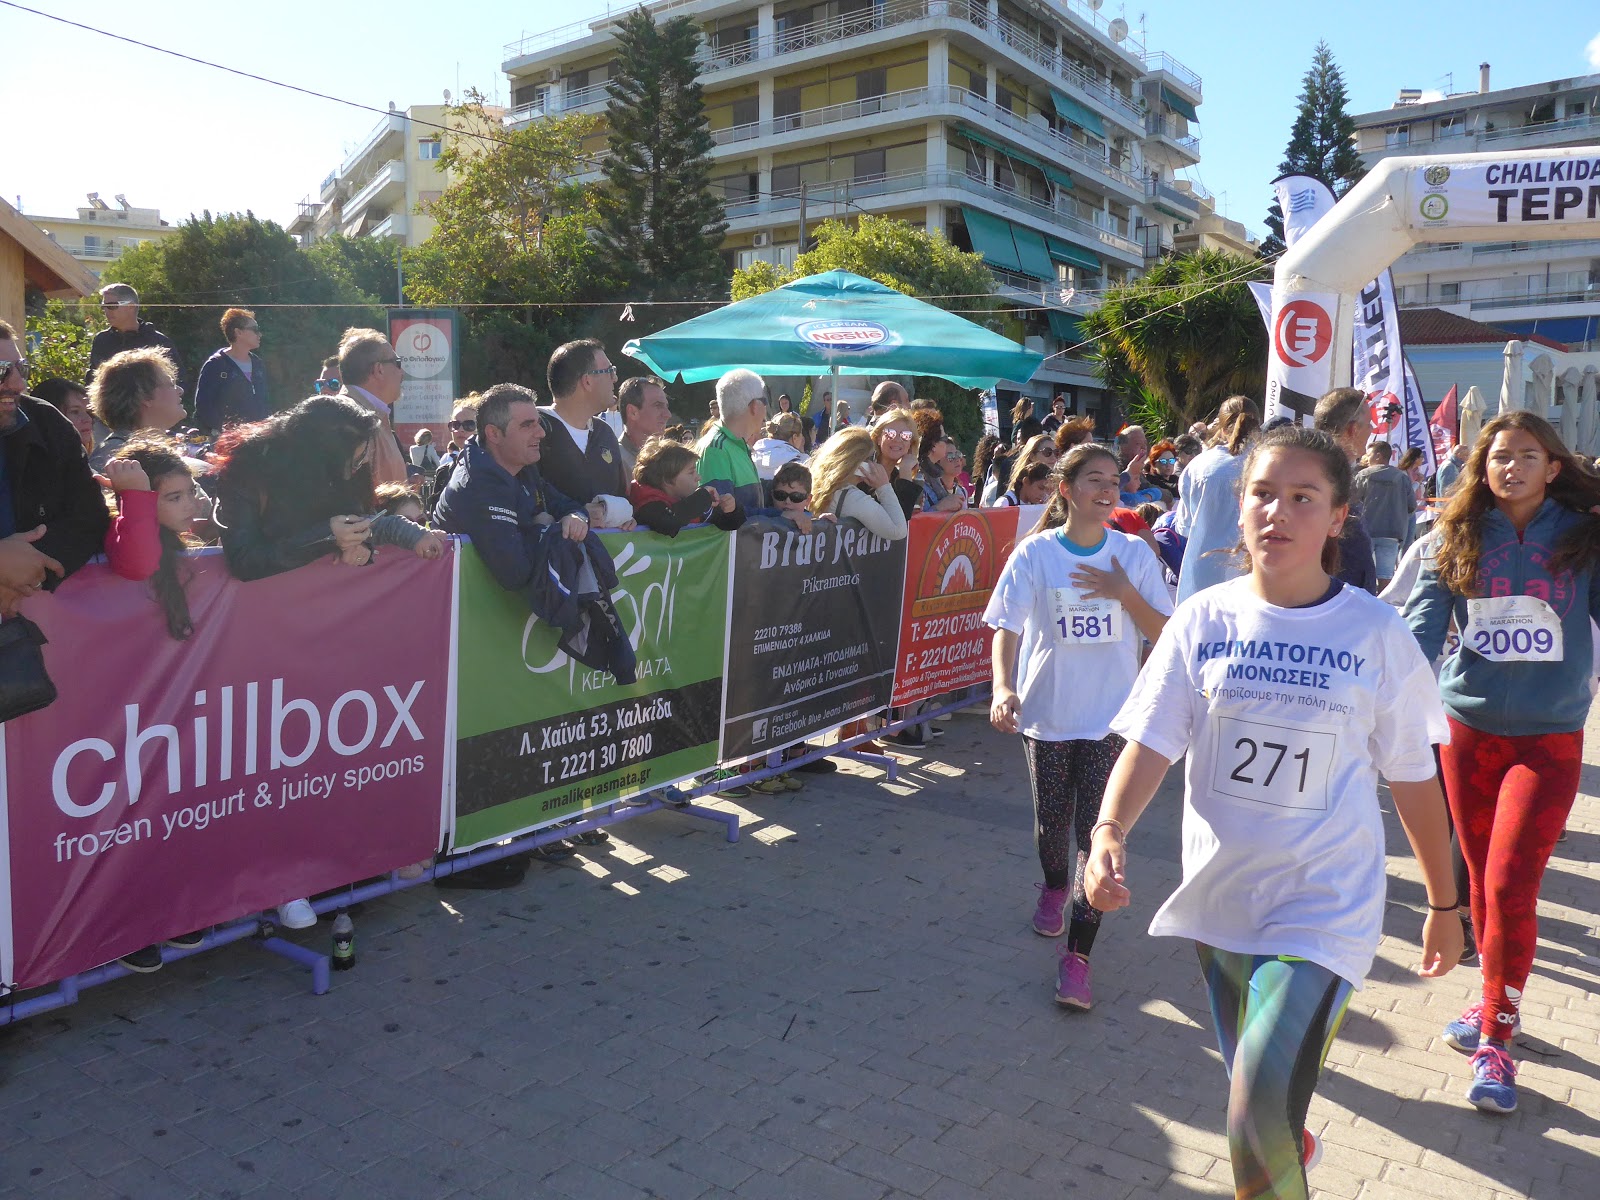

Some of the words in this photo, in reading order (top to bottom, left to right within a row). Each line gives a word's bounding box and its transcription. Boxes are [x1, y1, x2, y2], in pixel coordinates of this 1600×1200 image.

[830, 321, 868, 329] CREAM
[759, 530, 826, 570] Blue
[934, 538, 950, 561] La
[953, 521, 985, 556] Fiamma
[801, 572, 860, 595] Pikramenos
[754, 626, 778, 641] 22210
[911, 622, 920, 643] T:
[1056, 613, 1112, 638] 1581
[1489, 618, 1533, 626] MARATHON
[753, 636, 799, 655] ΕΠΙΜΕΝΙΔΟΥ
[804, 629, 831, 644] ΧΑΛΚΙΔΑ
[905, 652, 918, 673] F:
[919, 637, 985, 671] 2221028146
[1473, 628, 1554, 655] 2009
[772, 642, 869, 680] ΕΝΔΥΜΑΤΑ-ΥΠΟΔΗΜΑΤΑ
[1197, 640, 1366, 677] ΚΡΙΜΑΤΟΓΛΟΥ
[783, 672, 817, 695] Ανδρικό
[817, 672, 824, 684] &
[825, 661, 859, 682] Γυναικείο
[1226, 663, 1331, 690] ΜΟΝΩΣΕΙΣ
[772, 711, 784, 724] Find
[1275, 692, 1295, 706] την
[1297, 694, 1327, 712] πόλη
[519, 730, 537, 757] Λ.
[541, 718, 587, 751] Χαϊνά
[590, 711, 612, 738] 53,
[616, 699, 673, 729] Χαλκίδα
[771, 714, 808, 739] Facebook
[808, 712, 822, 725] Blue
[822, 706, 841, 720] Jeans
[51, 678, 426, 818] chillbox
[560, 750, 596, 781] 2221
[600, 742, 618, 769] 30
[621, 733, 653, 763] 7800
[1230, 737, 1311, 793] 271
[541, 767, 652, 812] amalikerasmata.gr
[53, 817, 152, 863] frozen
[162, 787, 246, 840] yogurt
[253, 781, 273, 808] &
[279, 770, 337, 809] juicy
[343, 754, 425, 793] spoons
